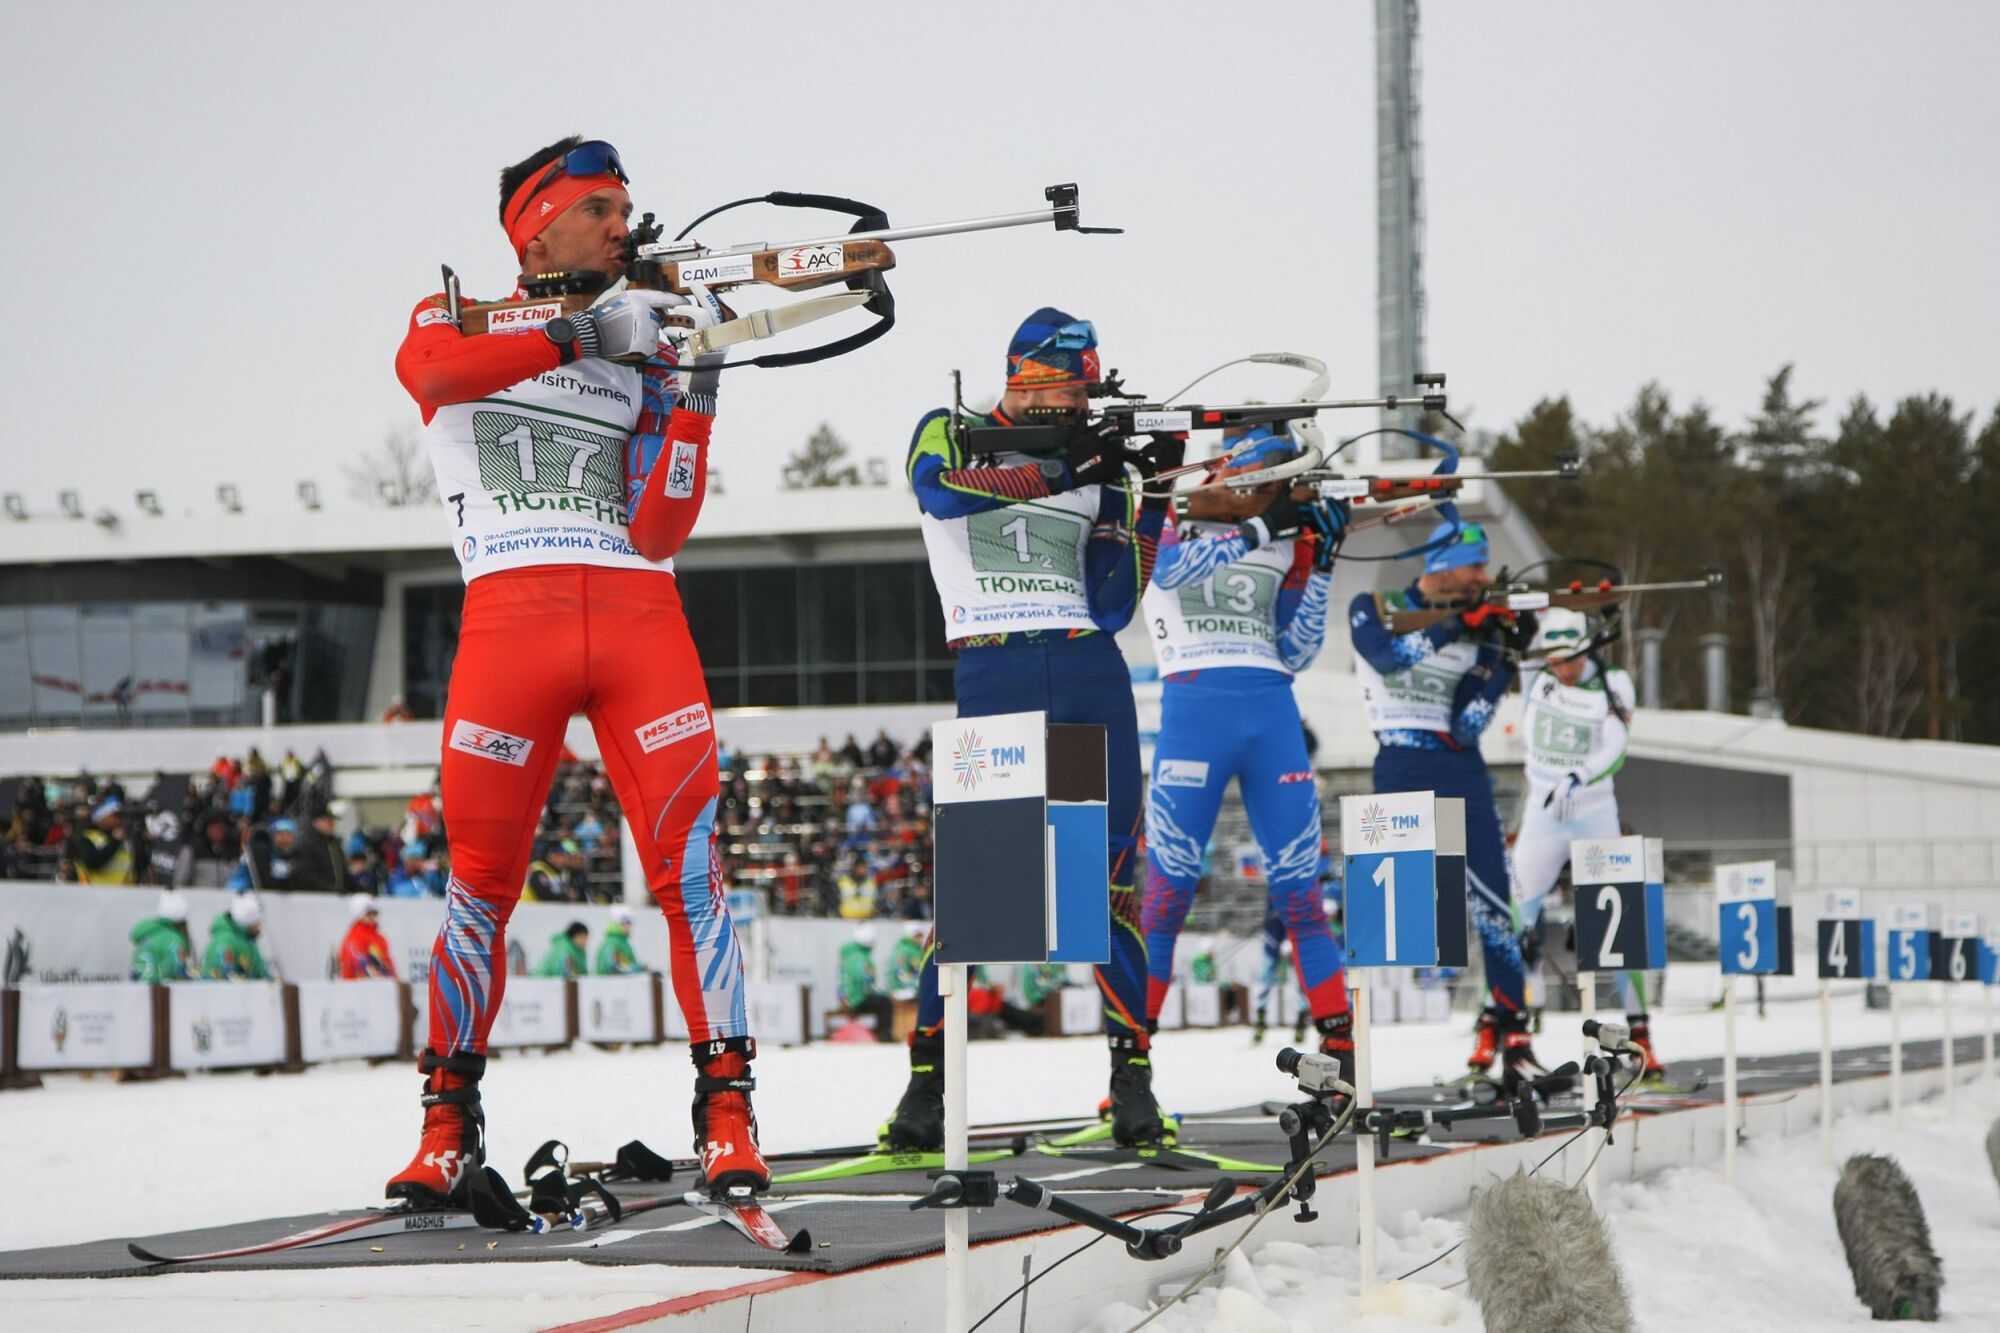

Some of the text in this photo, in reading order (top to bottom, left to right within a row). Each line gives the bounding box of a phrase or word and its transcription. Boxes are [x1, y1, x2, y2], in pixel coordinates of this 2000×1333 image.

[807, 252, 840, 268] AAC
[682, 267, 718, 281] СДМ
[492, 307, 556, 324] MS-Chip
[1137, 418, 1166, 428] СДМ
[497, 424, 602, 489] 17
[484, 525, 531, 542] ОБЛАСТНОЙ
[533, 526, 560, 534] ЦЕНТР
[562, 526, 599, 535] ЗИМНИХ
[1002, 516, 1031, 562] 1
[485, 536, 594, 557] ЖЕМЧУЖИНА
[1155, 618, 1168, 640] 3
[1185, 618, 1275, 644] ТЮМЕНЬ
[643, 709, 705, 741] MS-Chip
[487, 739, 522, 757] AAC
[991, 746, 1025, 767] TMN
[1391, 814, 1419, 829] TMN
[1608, 854, 1632, 865] TMN
[1372, 857, 1397, 962] 1
[1596, 885, 1624, 968] 2
[1737, 903, 1759, 970] 3
[1827, 919, 1848, 977] 4
[1900, 931, 1916, 980] 5
[1949, 938, 1967, 981] 6
[404, 1216, 445, 1230] MADSHUS
